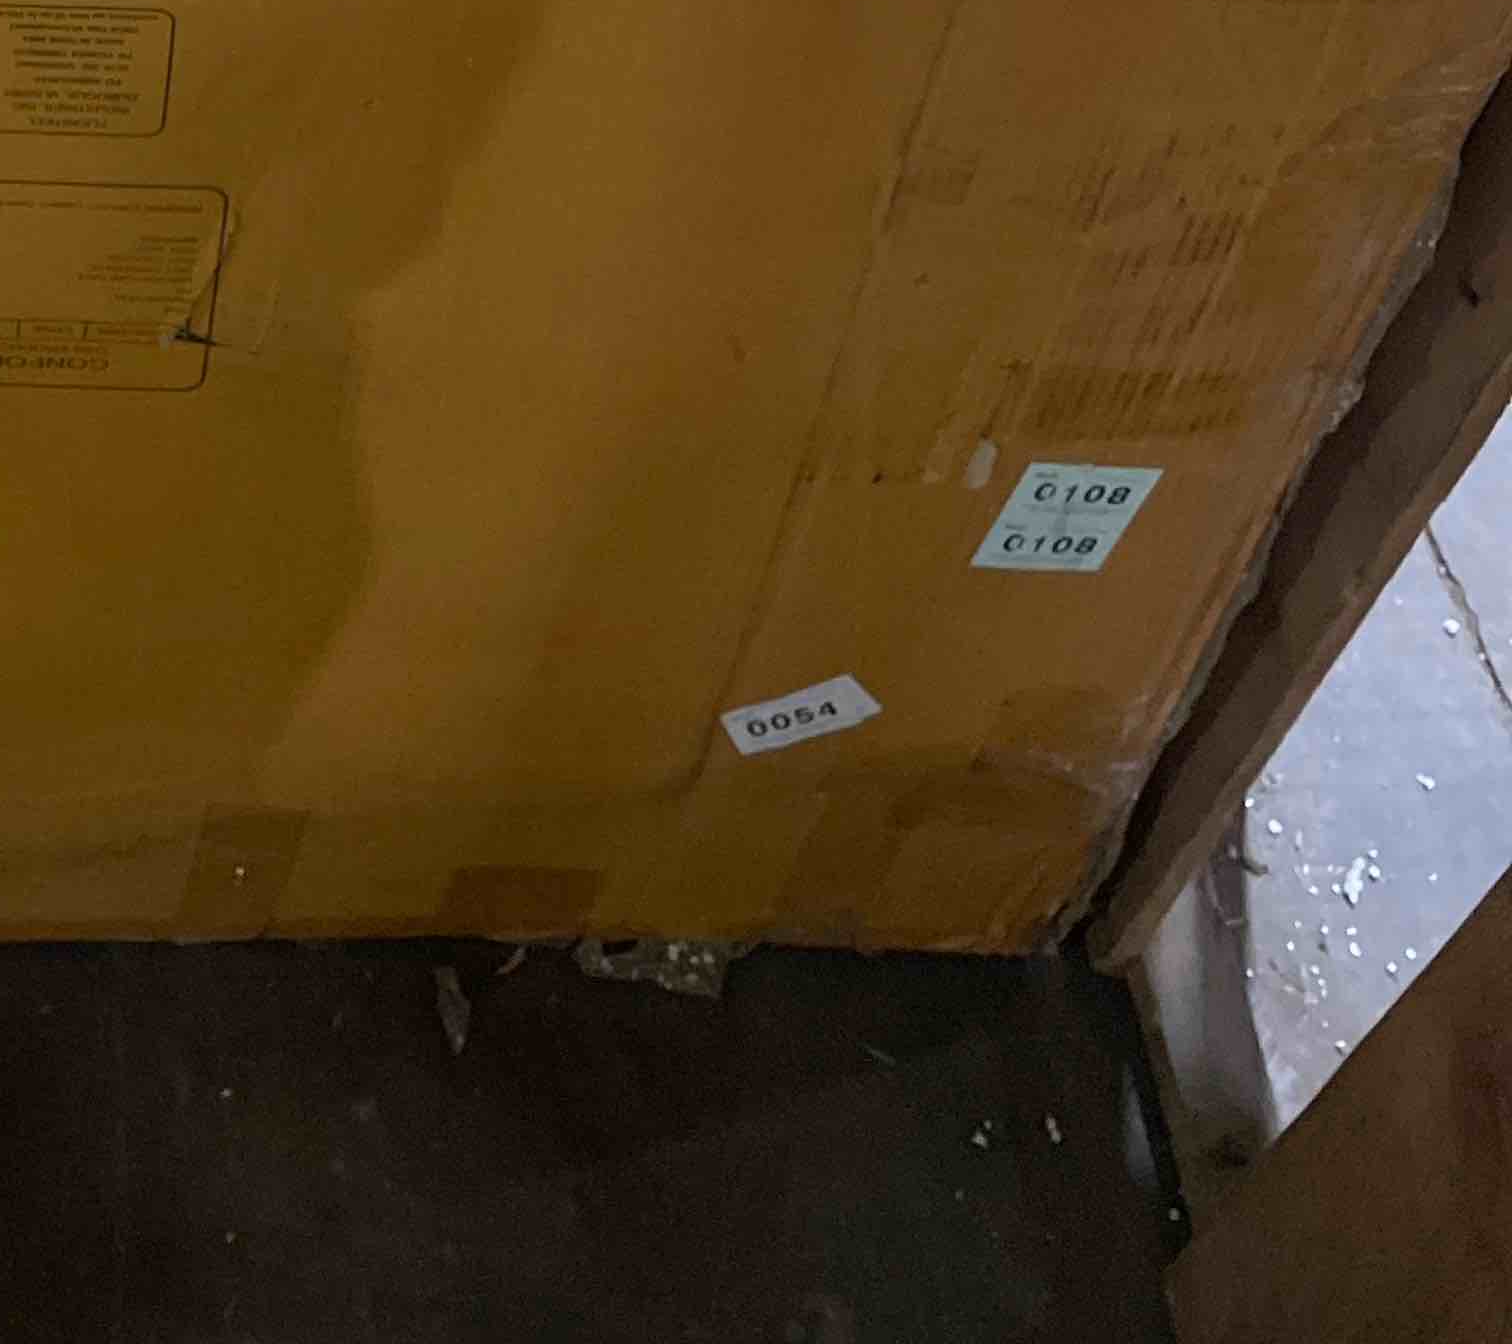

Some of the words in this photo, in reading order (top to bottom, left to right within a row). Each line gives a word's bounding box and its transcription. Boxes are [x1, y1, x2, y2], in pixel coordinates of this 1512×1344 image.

[1034, 482, 1131, 505] 0108
[1003, 533, 1098, 554] 0108
[746, 701, 839, 737] 0054
